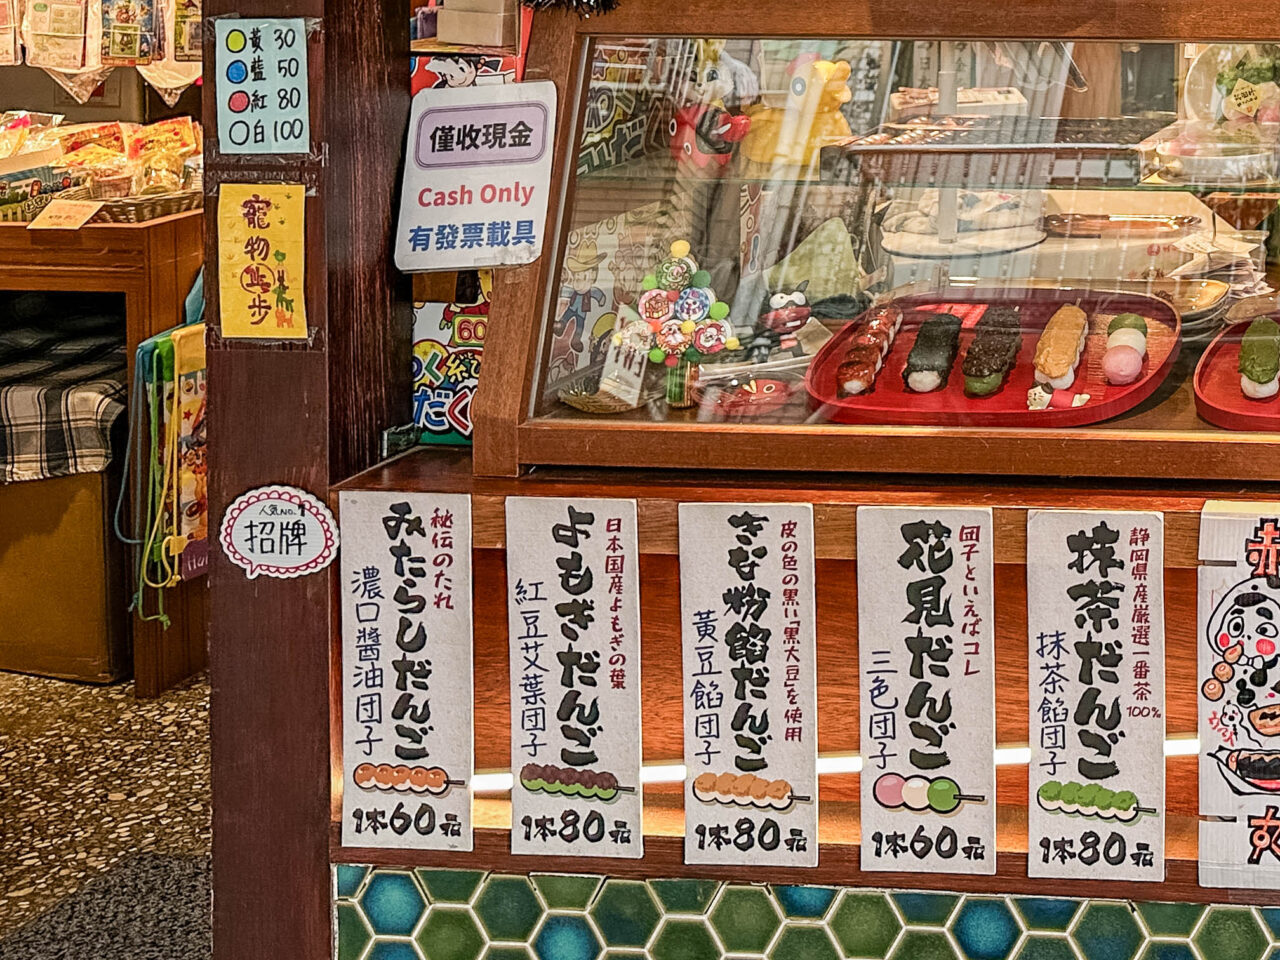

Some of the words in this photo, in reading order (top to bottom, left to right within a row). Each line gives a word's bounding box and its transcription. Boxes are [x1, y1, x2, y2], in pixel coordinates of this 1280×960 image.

[250, 56, 266, 81] 藍
[277, 57, 299, 77] 50
[273, 28, 296, 49] 30
[250, 89, 268, 113] 紅
[277, 86, 301, 109] 80
[252, 119, 265, 144] 白
[273, 117, 304, 143] 100
[429, 120, 534, 153] 僅收現金
[408, 219, 537, 251] 有發票載具
[417, 187, 473, 209] Cash
[480, 181, 535, 208] Only
[243, 519, 308, 556] 招牌
[430, 506, 455, 611] 秘伝のたれ
[382, 501, 434, 761] みたらしだんご
[551, 505, 603, 766] よもぎだんご
[604, 517, 628, 690] 日本国産よもぎの葉
[898, 519, 957, 773] 花見だんご
[958, 525, 982, 676] 団子といえばコレ
[1066, 520, 1126, 781] 抹茶だんご
[865, 649, 898, 770] 三色団子
[1035, 630, 1069, 776] 抹茶餡団子
